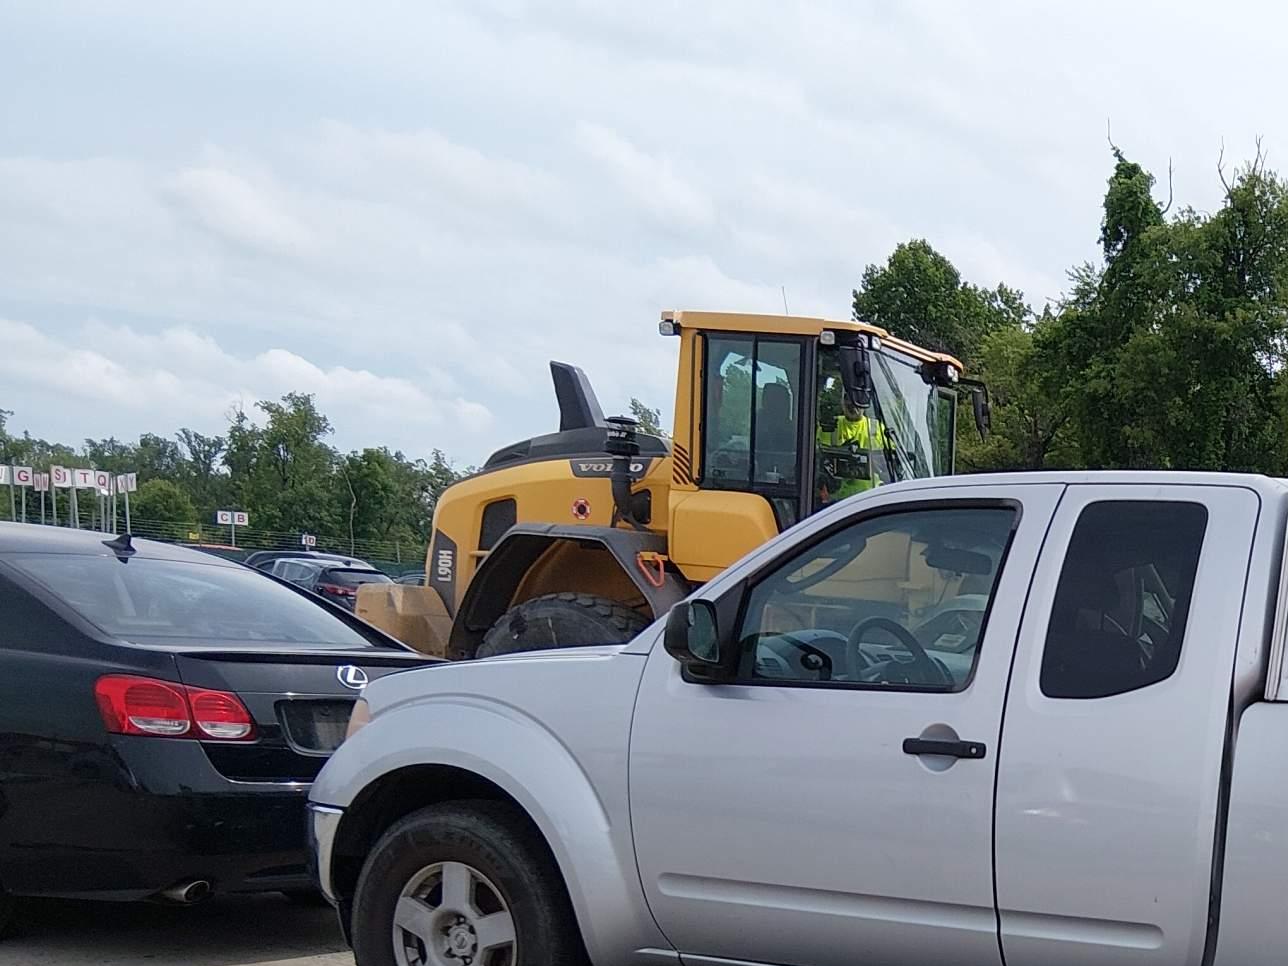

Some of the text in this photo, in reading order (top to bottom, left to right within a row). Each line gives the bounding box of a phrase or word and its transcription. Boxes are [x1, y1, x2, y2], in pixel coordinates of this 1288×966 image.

[579, 463, 644, 472] VOLO
[18, 470, 29, 481] G
[55, 469, 61, 480] S
[80, 473, 88, 483] T
[97, 474, 107, 487] Q
[220, 513, 229, 522] C
[237, 514, 245, 523] B
[438, 549, 453, 582] L90H
